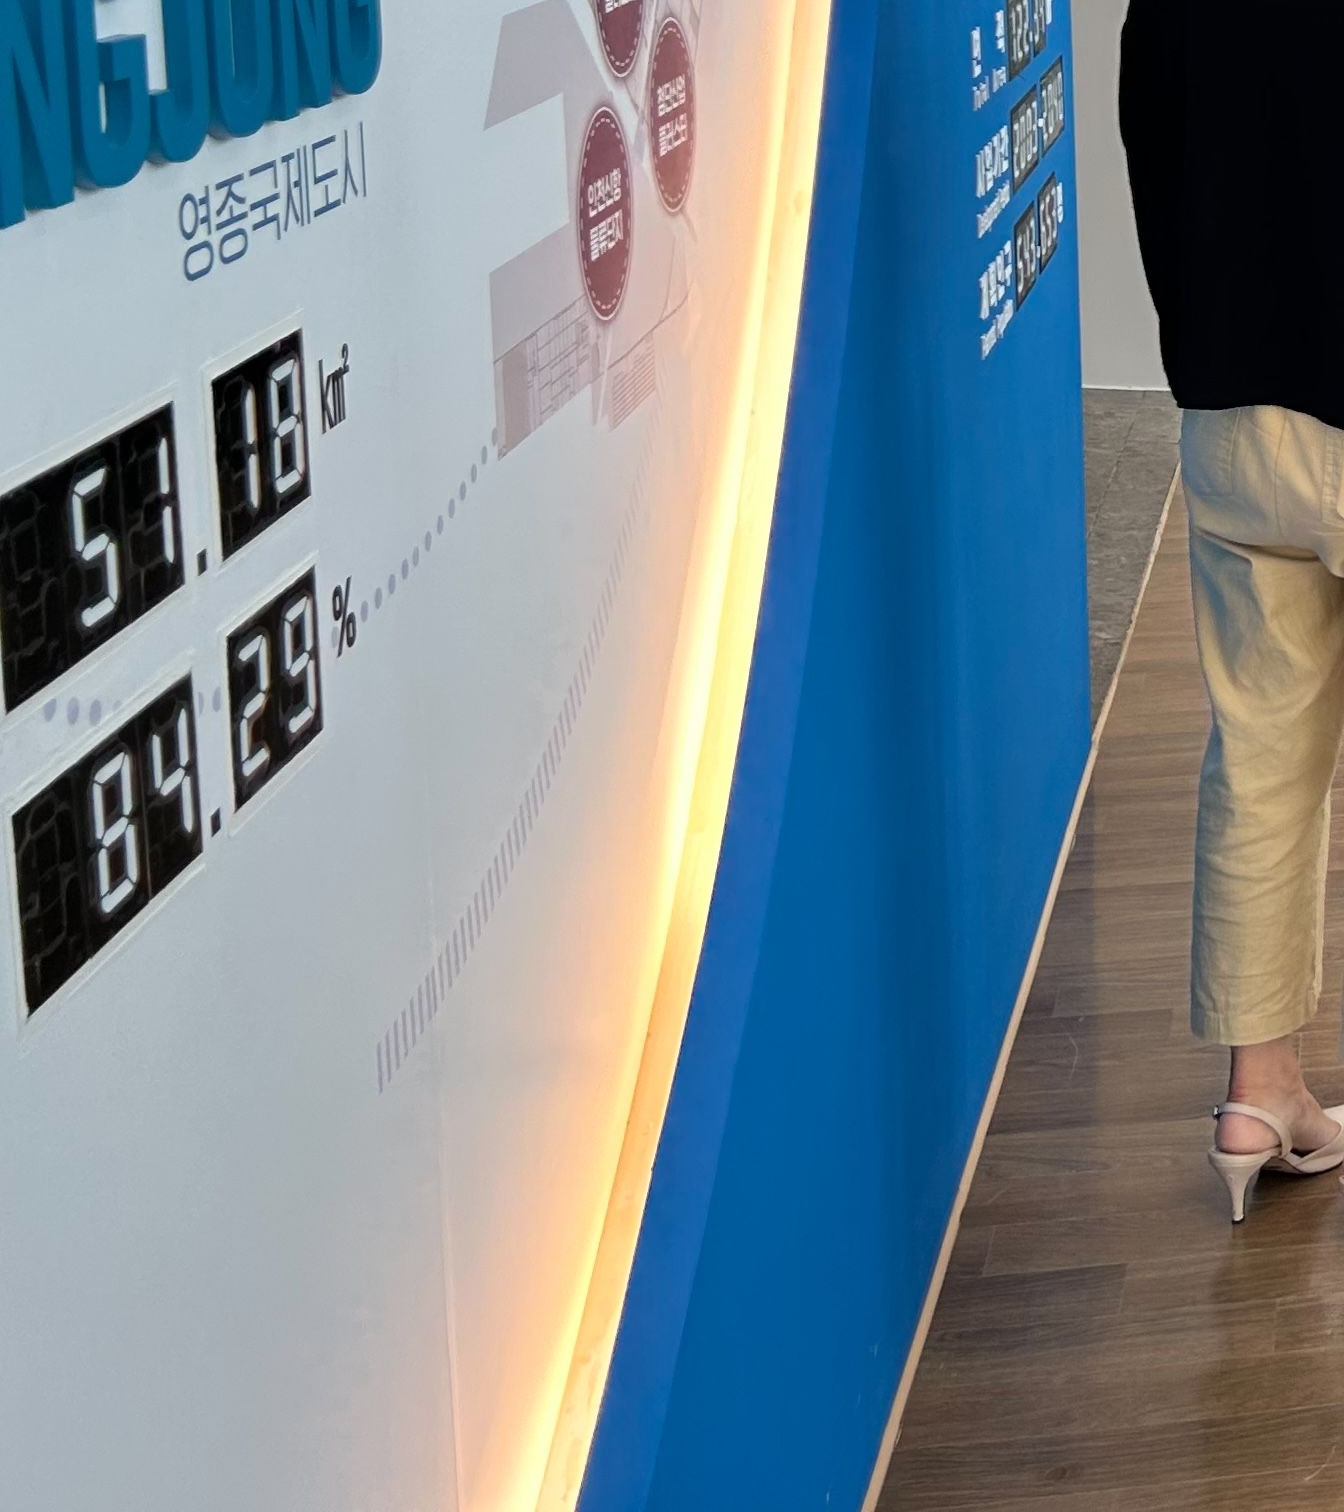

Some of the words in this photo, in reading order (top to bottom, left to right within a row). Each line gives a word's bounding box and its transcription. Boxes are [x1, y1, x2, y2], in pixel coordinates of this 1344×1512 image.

[179, 121, 368, 282] 영종국제도시
[587, 168, 622, 218] 인천신항
[589, 209, 624, 262] 물류단지
[70, 353, 304, 630] 51.18
[92, 595, 319, 914] 84.29
[332, 576, 357, 658] %
